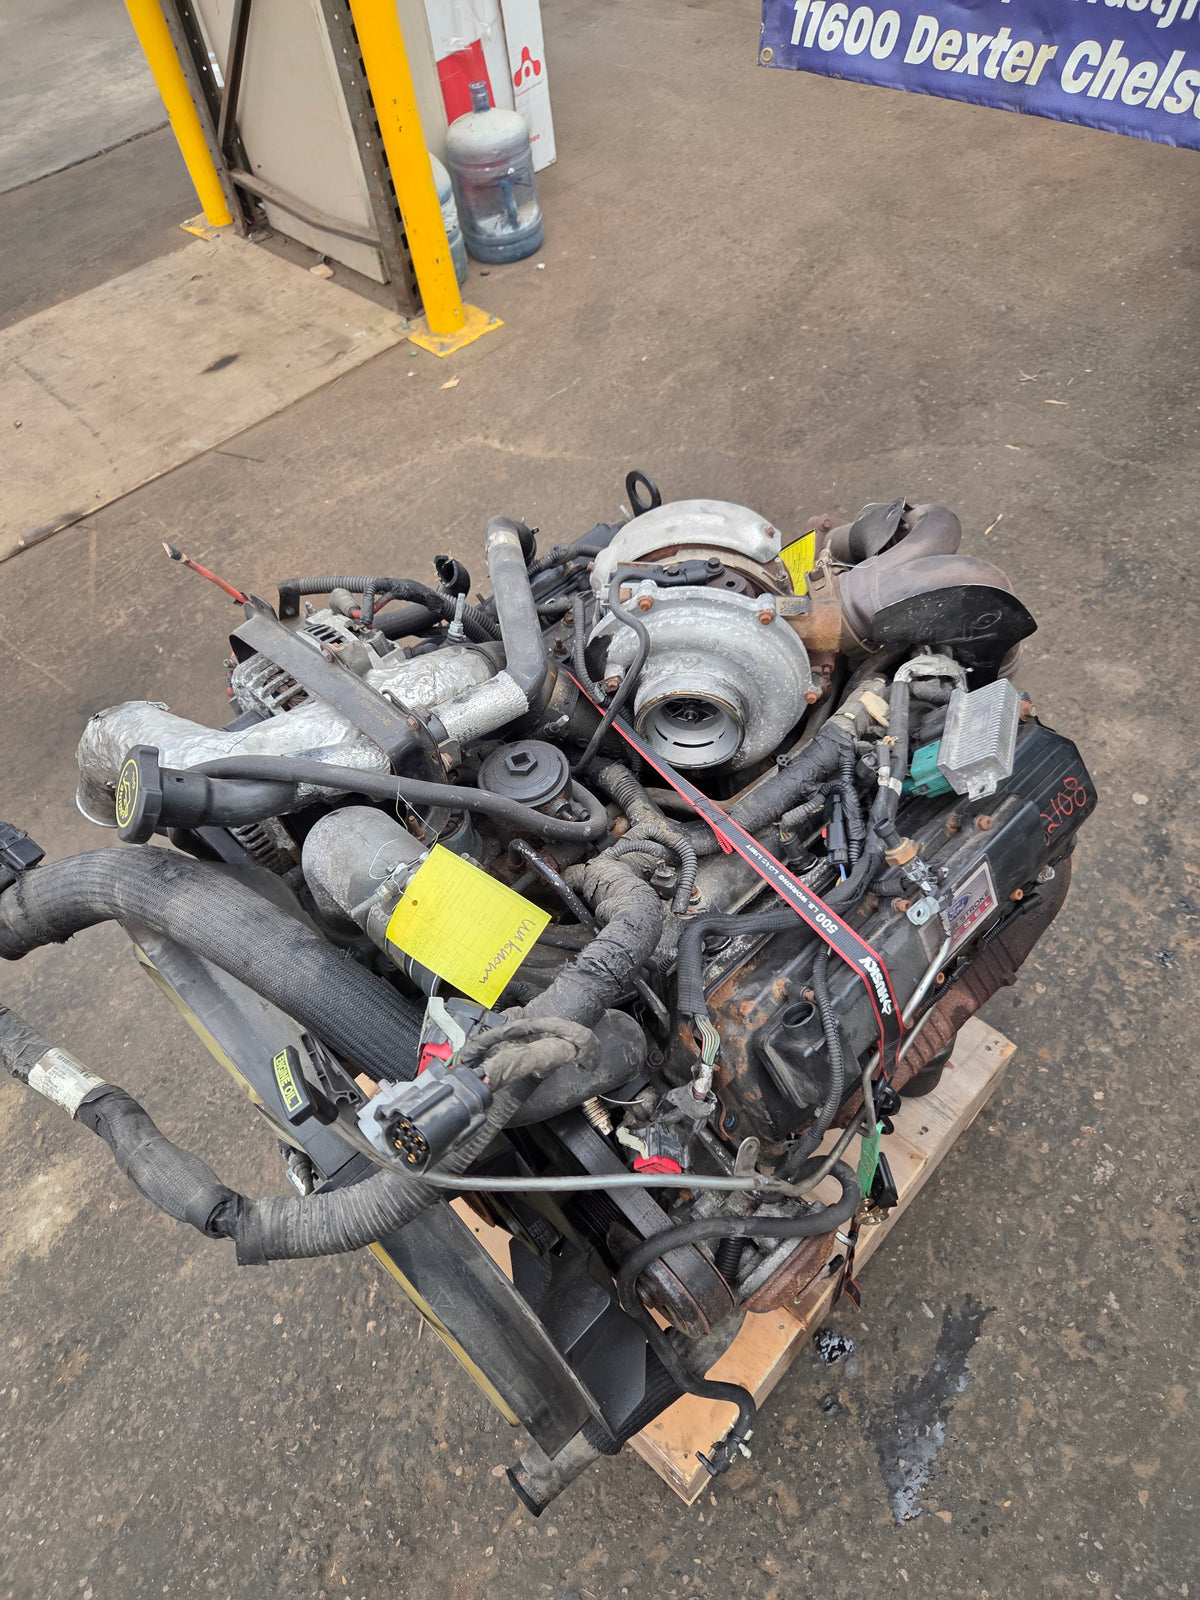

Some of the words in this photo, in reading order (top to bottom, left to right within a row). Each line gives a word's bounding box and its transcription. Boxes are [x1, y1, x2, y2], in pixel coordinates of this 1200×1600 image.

[790, 0, 901, 60] 11600
[903, 15, 1058, 86] Dexter
[1060, 39, 1200, 120] Chels
[745, 844, 764, 860] LIMIT
[778, 874, 808, 903] WORKING
[807, 901, 820, 913] LB.
[815, 912, 839, 935] 500
[858, 956, 890, 1004] HUSKY
[275, 1054, 292, 1087] ENGINE
[284, 1085, 297, 1105] OIL
